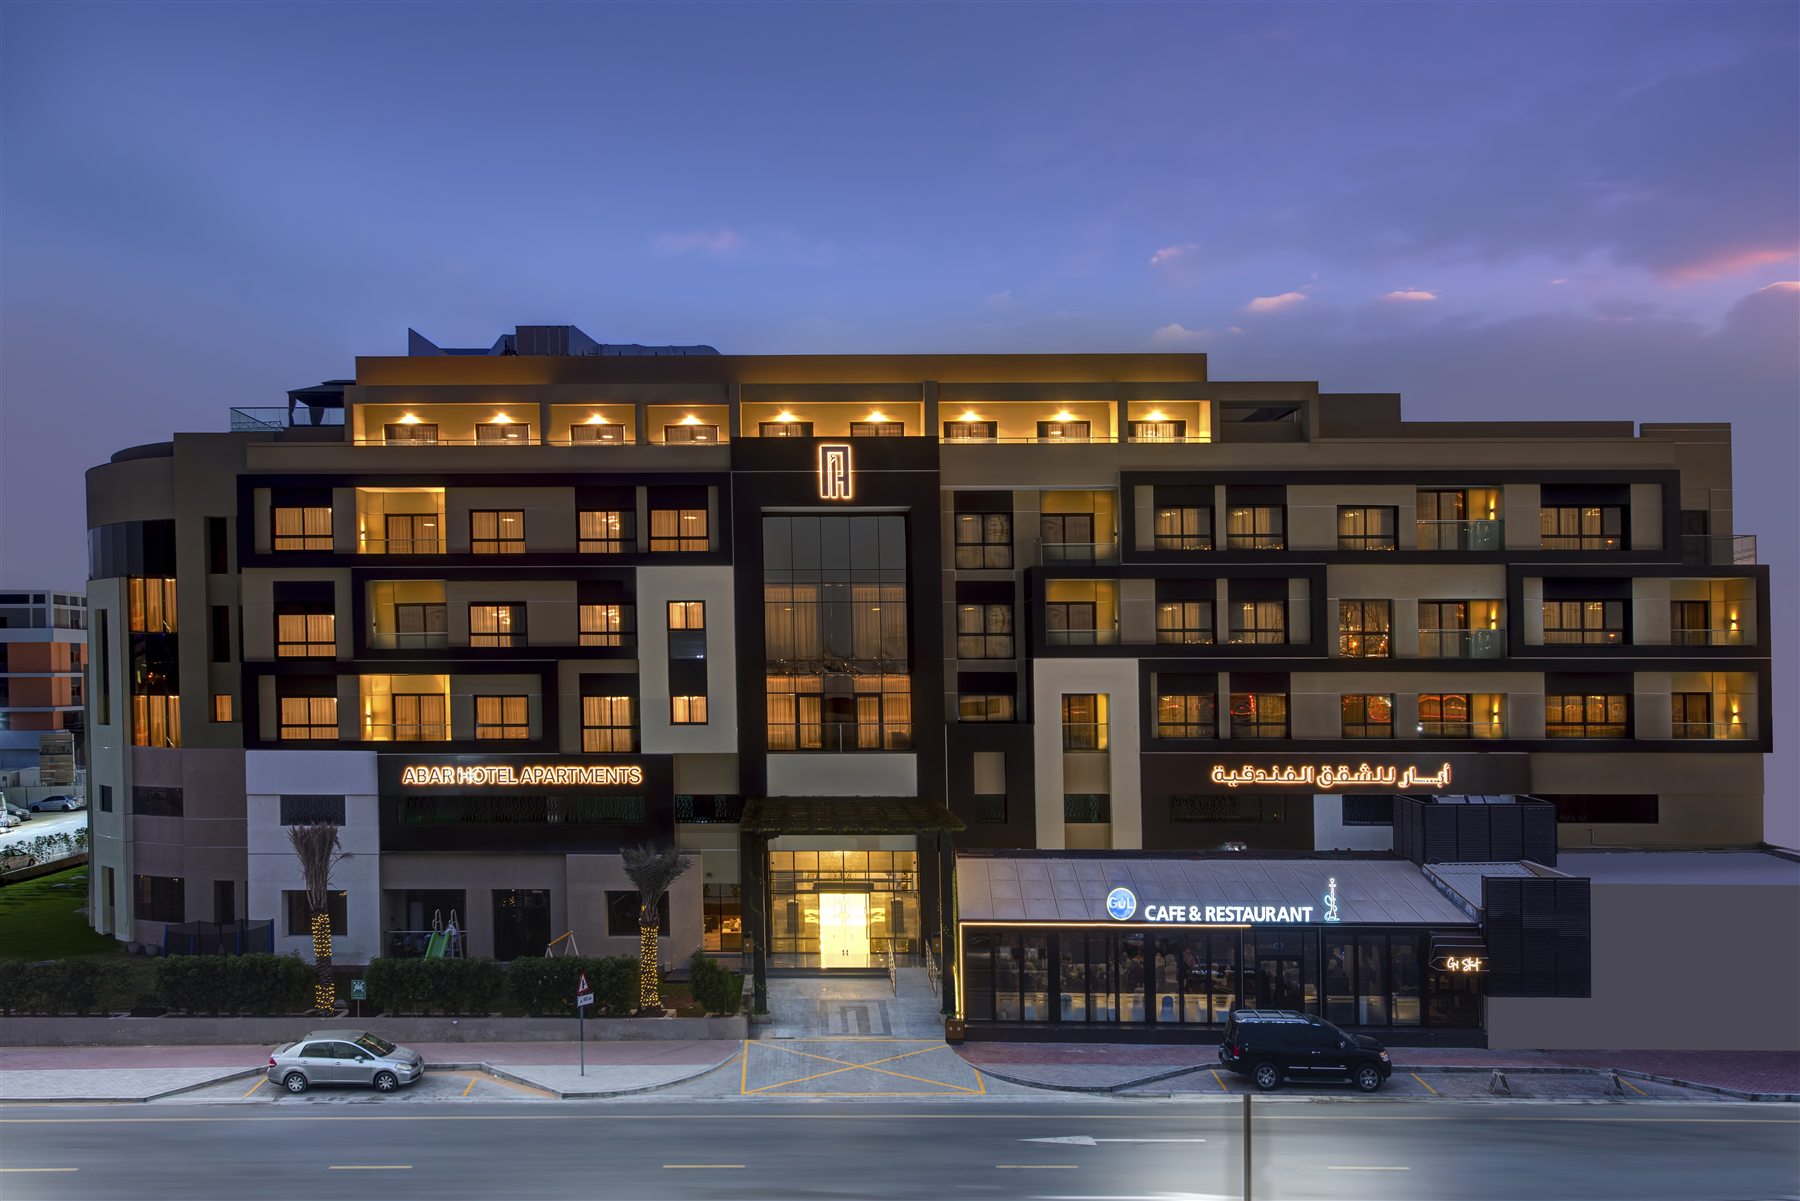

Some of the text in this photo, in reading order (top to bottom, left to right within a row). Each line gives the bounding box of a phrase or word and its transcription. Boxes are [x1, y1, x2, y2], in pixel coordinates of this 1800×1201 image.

[402, 766, 643, 785] ABAR HOTEL APARTMENTS
[1211, 765, 1315, 787] الفندقية
[1316, 763, 1396, 788] للشقق
[1144, 905, 1313, 923] CAFE & RESTAURANT
